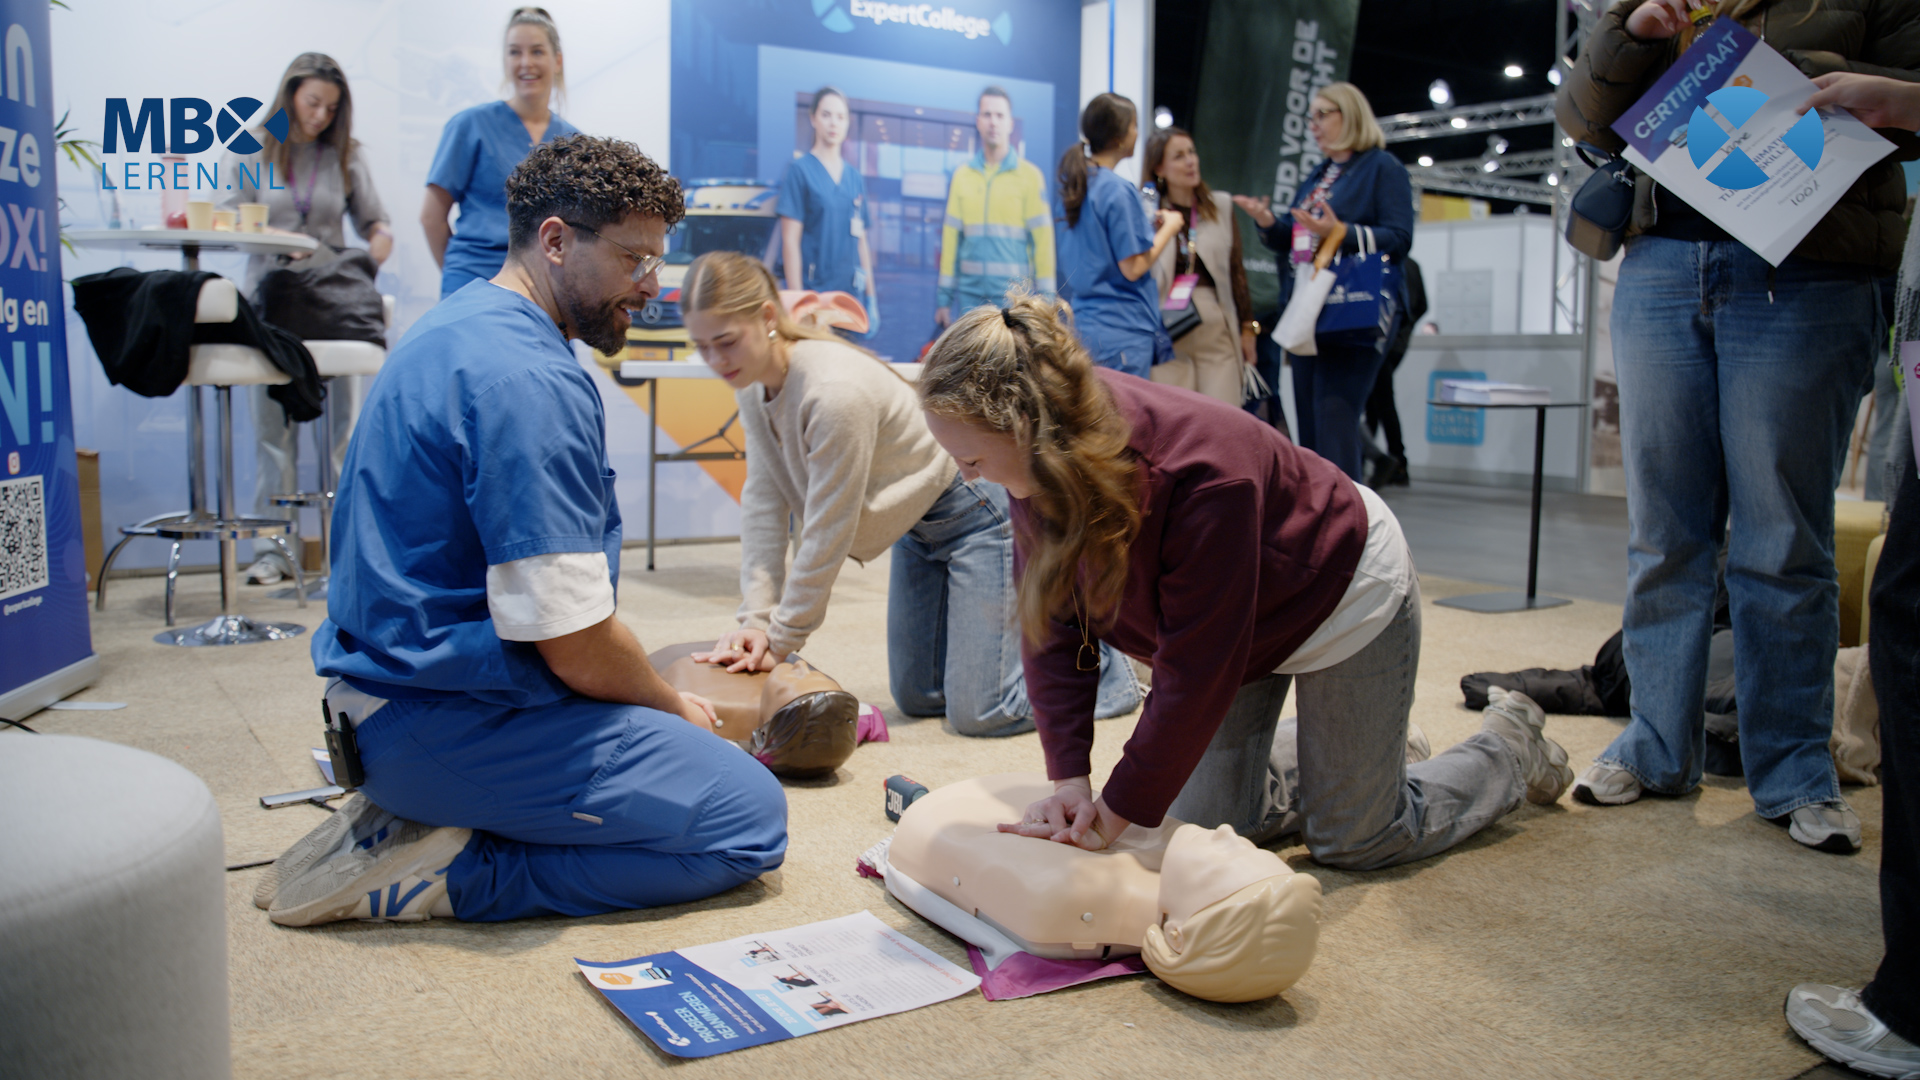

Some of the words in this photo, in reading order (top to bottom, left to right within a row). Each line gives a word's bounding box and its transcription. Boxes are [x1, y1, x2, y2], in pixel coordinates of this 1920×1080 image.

[851, 0, 991, 39] ExpertCollege
[1292, 18, 1320, 63] DE
[1634, 30, 1740, 139] CERTIFICAAT
[1280, 67, 1311, 156] VOOR
[23, 300, 48, 326] en
[674, 1007, 720, 1043] PROBEER
[678, 991, 739, 1040] REANIMEREN
[773, 1007, 789, 1017] DOE
